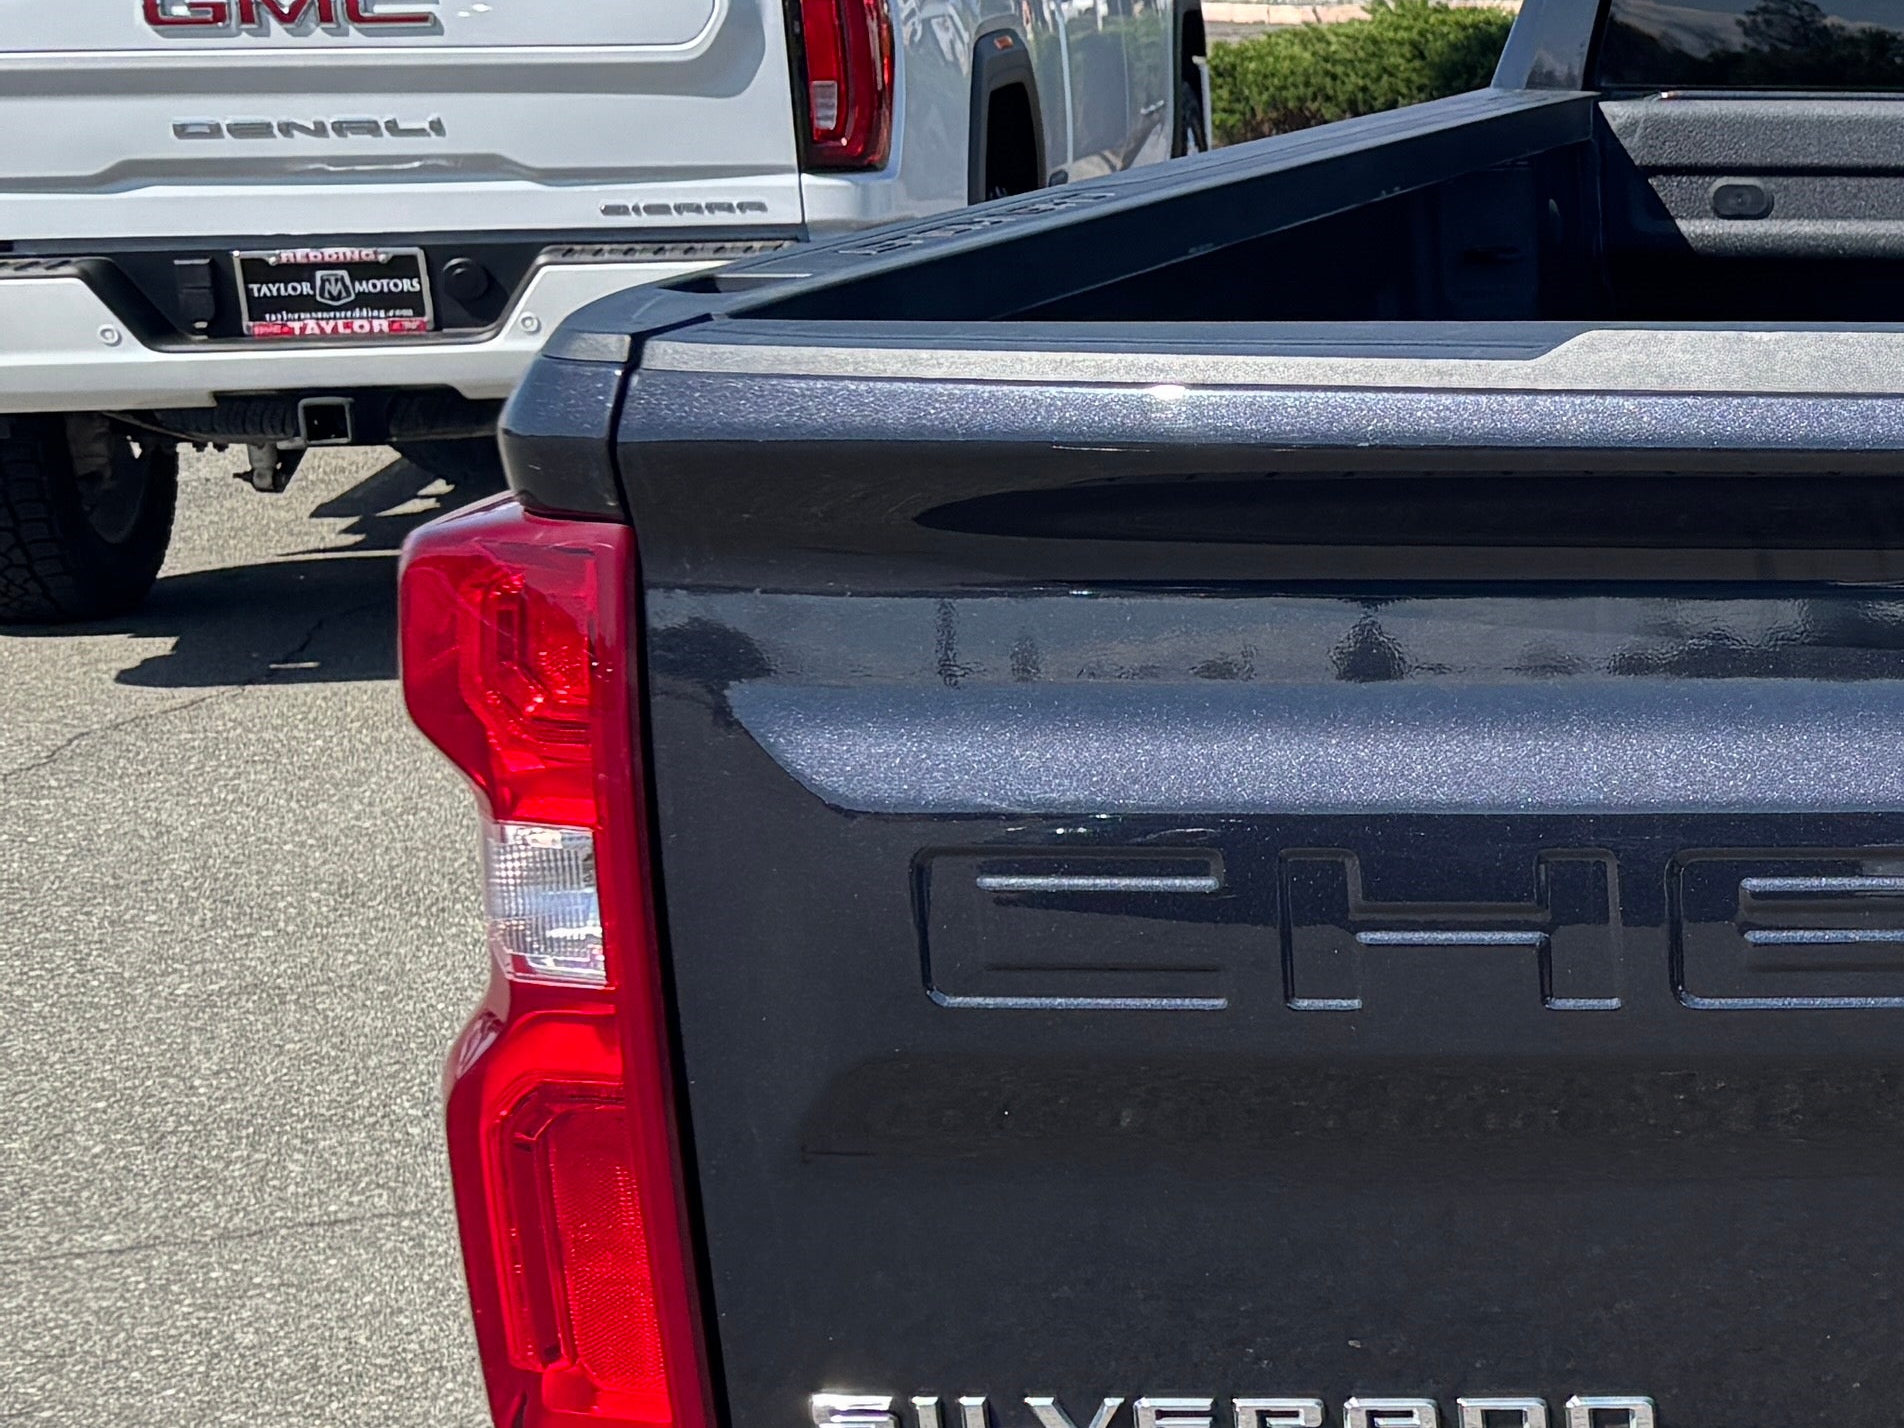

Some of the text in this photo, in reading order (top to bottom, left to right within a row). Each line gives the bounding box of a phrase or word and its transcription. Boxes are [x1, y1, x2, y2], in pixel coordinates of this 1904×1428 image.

[171, 115, 447, 140] DENALI
[249, 282, 314, 298] TAYLOR
[354, 278, 420, 294] MOTORS
[287, 319, 389, 335] TAYLOR
